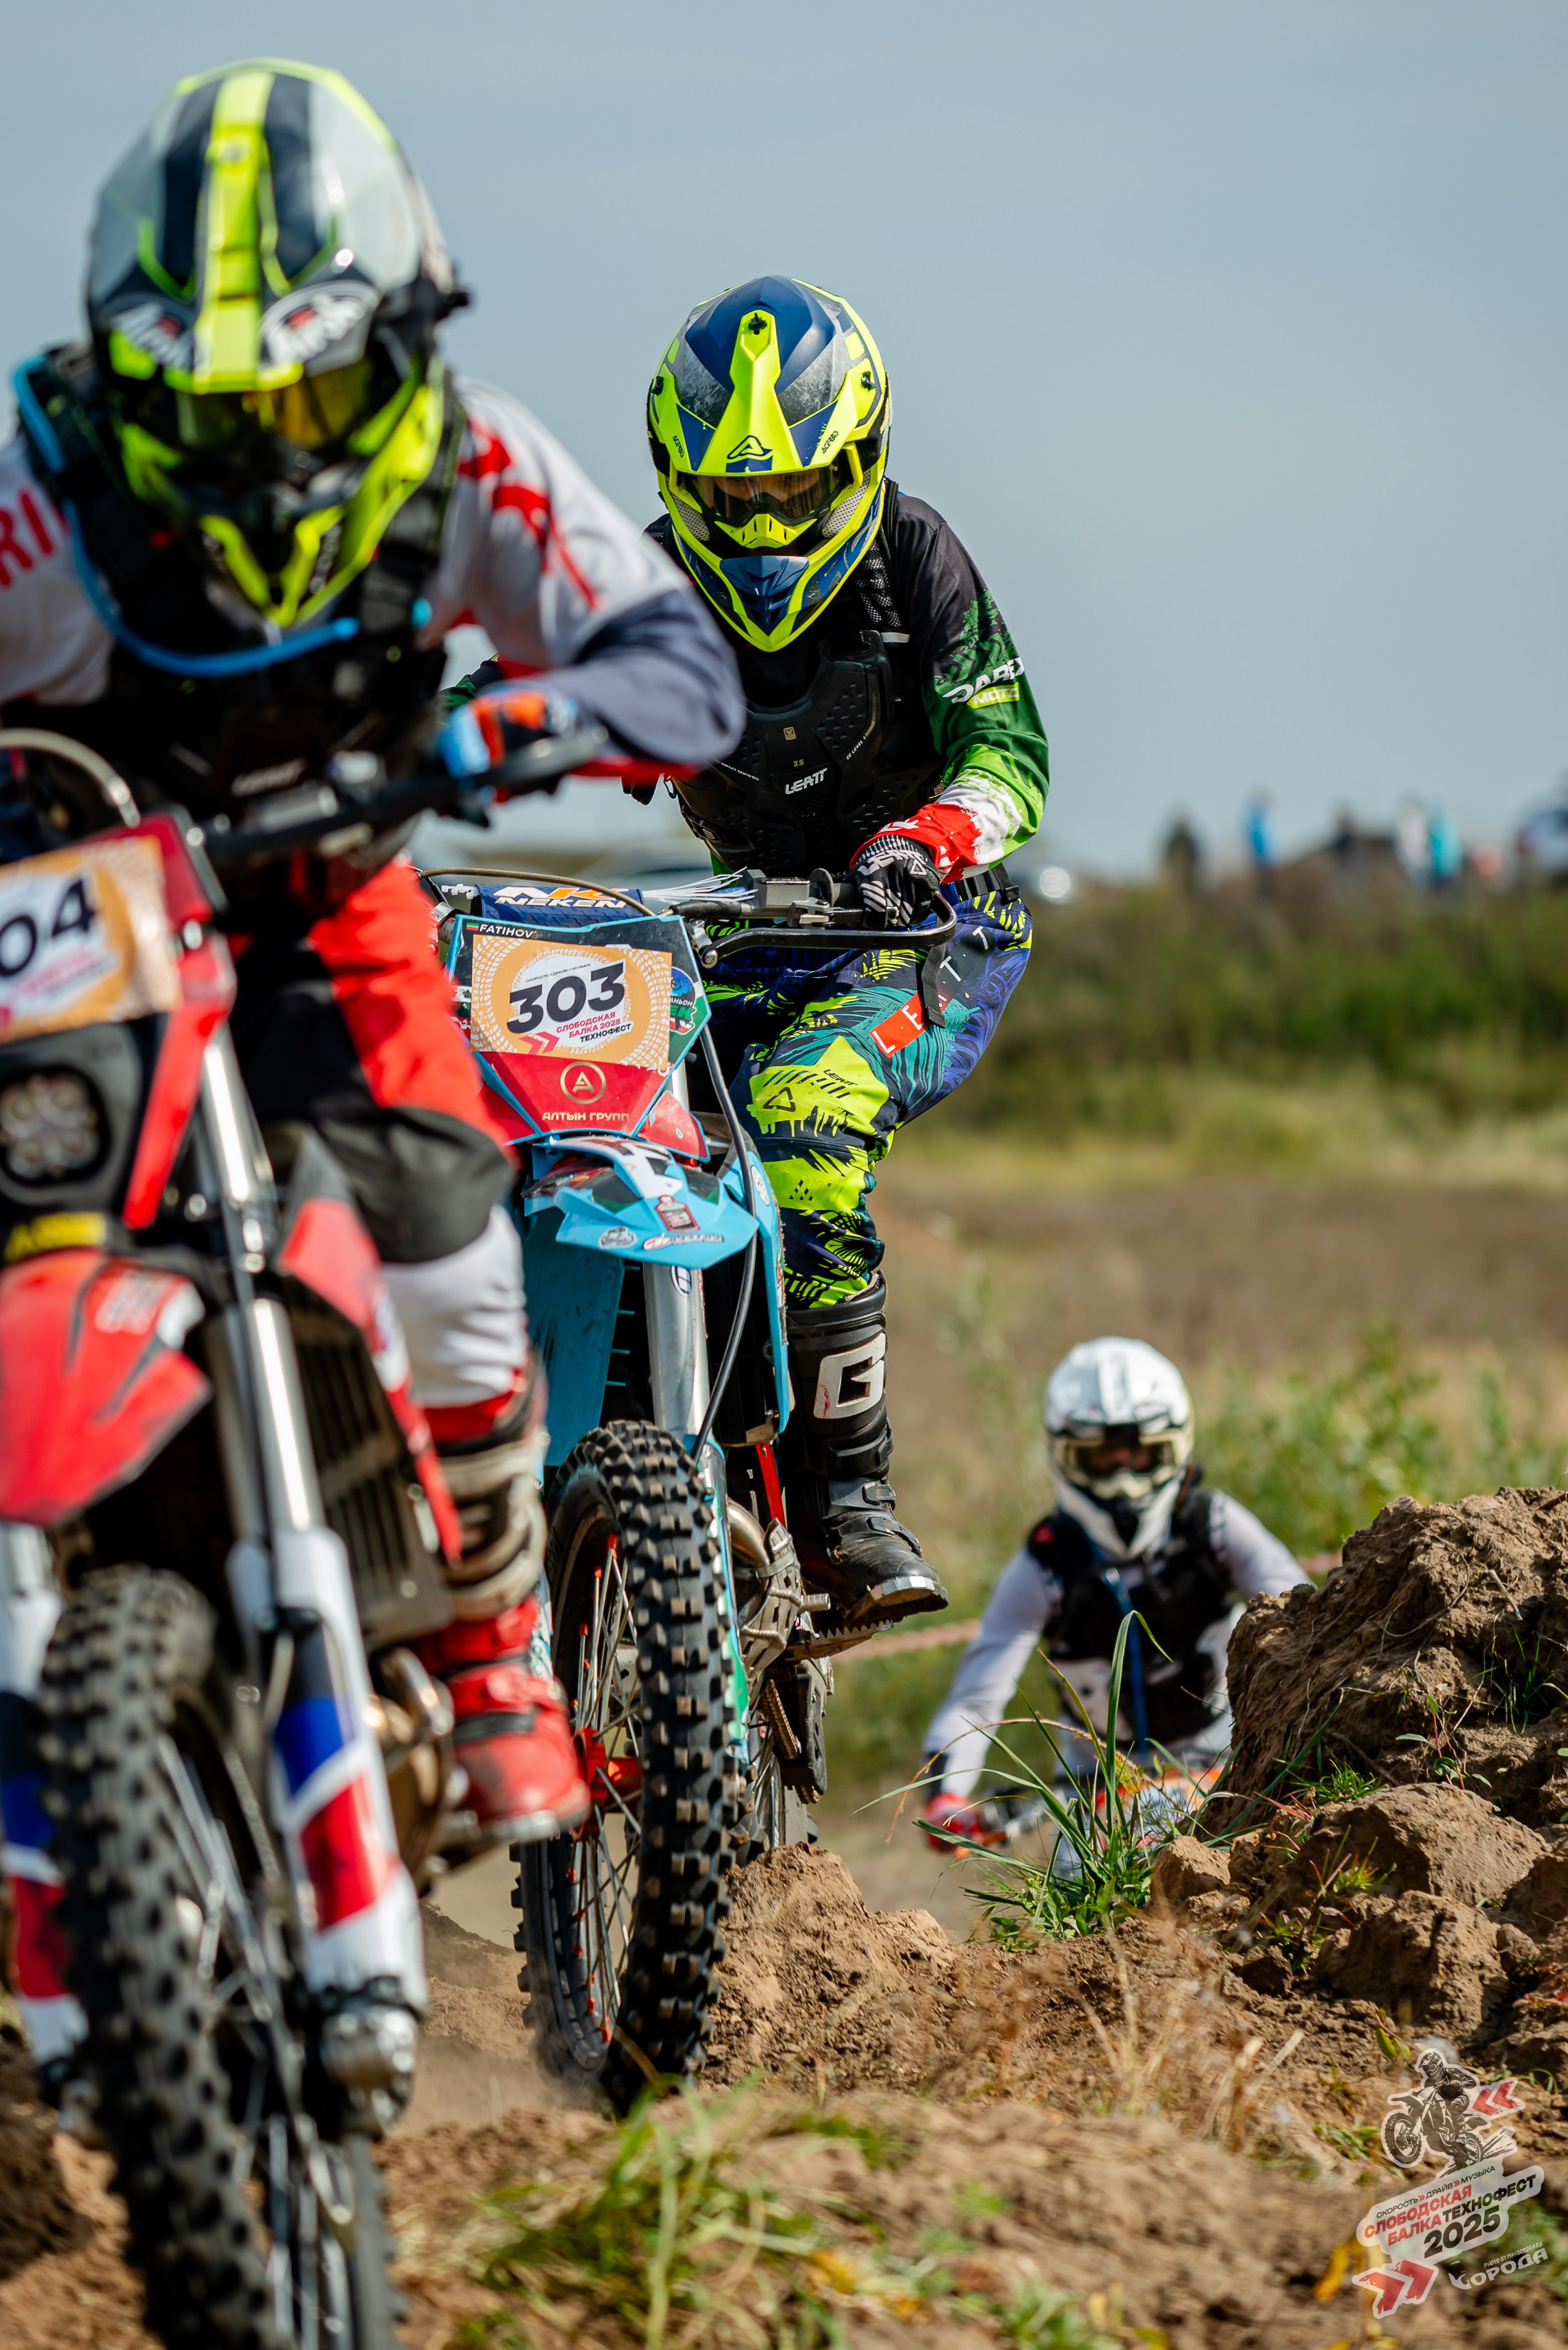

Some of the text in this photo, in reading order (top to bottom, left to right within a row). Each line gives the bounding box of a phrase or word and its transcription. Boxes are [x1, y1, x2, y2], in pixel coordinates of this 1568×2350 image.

[785, 768, 827, 795] LEATT
[494, 897, 627, 909] NEKEN
[479, 924, 534, 939] FATIHOV
[506, 962, 625, 1034] 303
[556, 1011, 616, 1033] СЛОБОДСКАЯ
[569, 1019, 621, 1038] БАЛКА 2025
[580, 1023, 632, 1043] ТЕХНОФЕСТ
[542, 1112, 629, 1122] АЛТЫН ГРУПП
